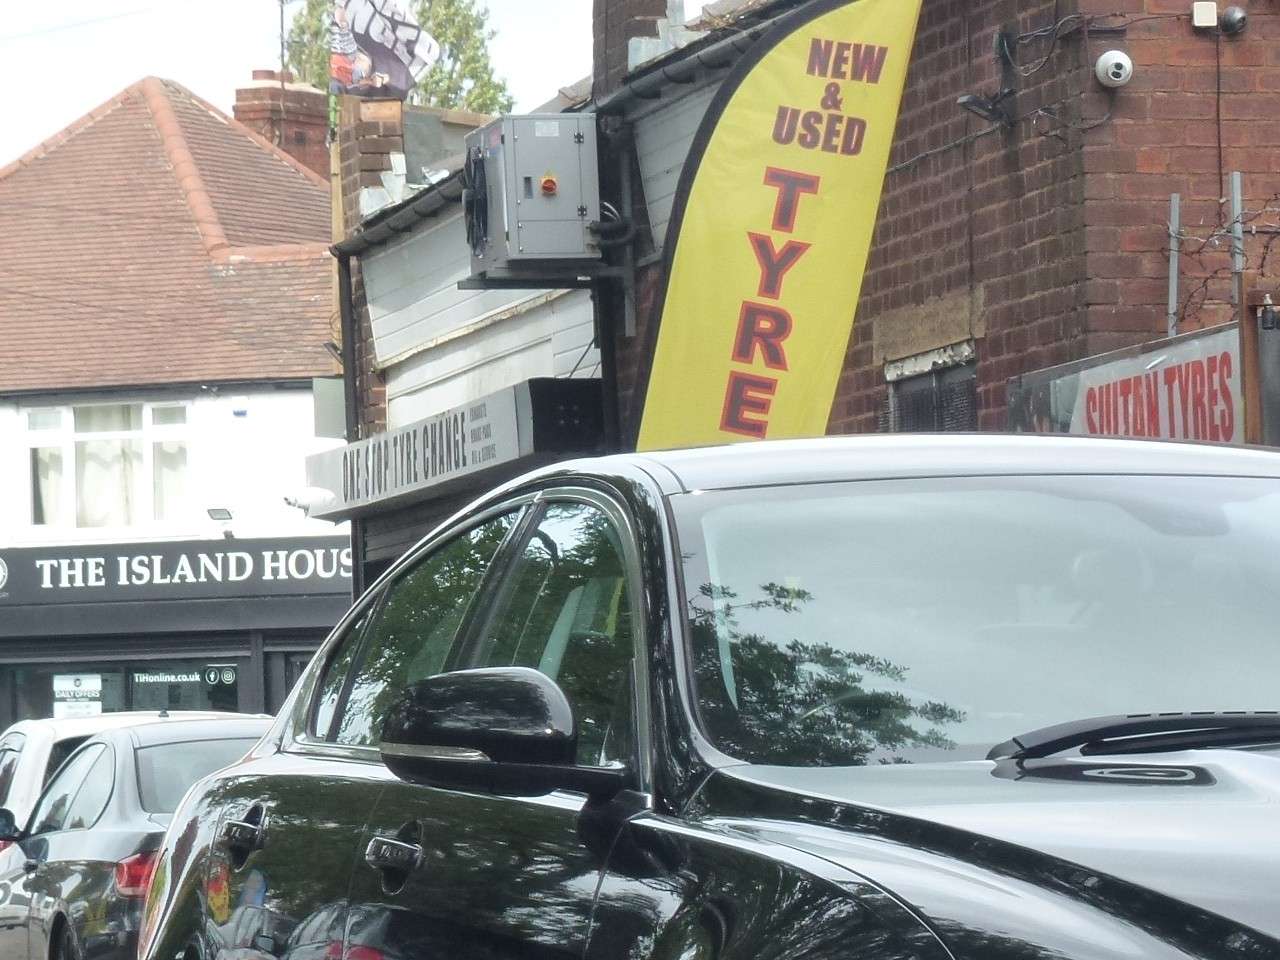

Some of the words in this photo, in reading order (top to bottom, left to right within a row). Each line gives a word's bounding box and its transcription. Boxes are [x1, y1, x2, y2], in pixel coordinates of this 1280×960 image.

[806, 38, 888, 84] NEW
[820, 82, 844, 111] &
[771, 105, 867, 156] USED
[719, 166, 820, 440] TYRE
[1163, 351, 1234, 442] TYRES
[342, 448, 360, 503] ONE
[365, 440, 389, 497] STOP
[393, 429, 418, 488] TYRE
[423, 411, 467, 480] CHANGE
[35, 557, 105, 588] THE
[117, 551, 253, 585] ISLAND
